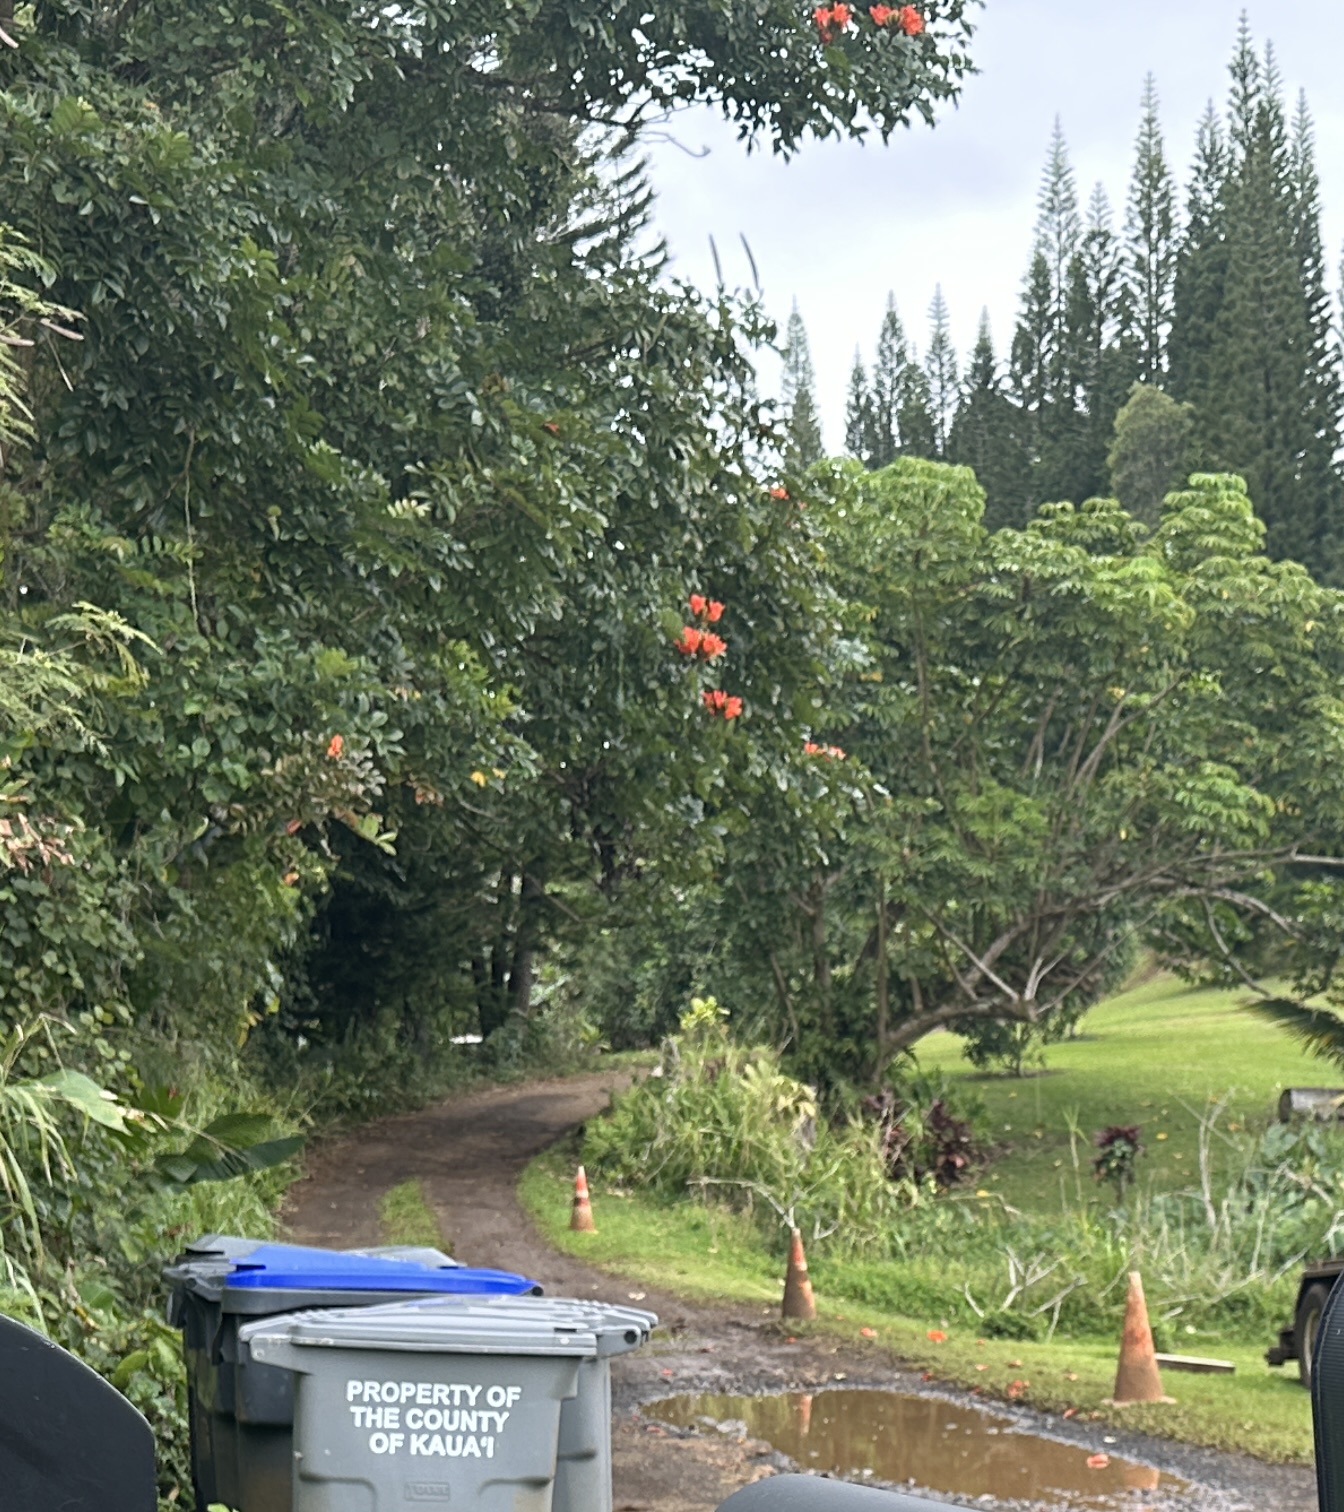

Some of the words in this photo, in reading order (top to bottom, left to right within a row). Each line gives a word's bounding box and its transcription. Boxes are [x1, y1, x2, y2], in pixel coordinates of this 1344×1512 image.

[346, 1380, 482, 1406] PROPERTY
[486, 1385, 522, 1408] OF
[349, 1405, 401, 1429] THE
[405, 1408, 510, 1433] COUNTY
[369, 1432, 404, 1455] OF
